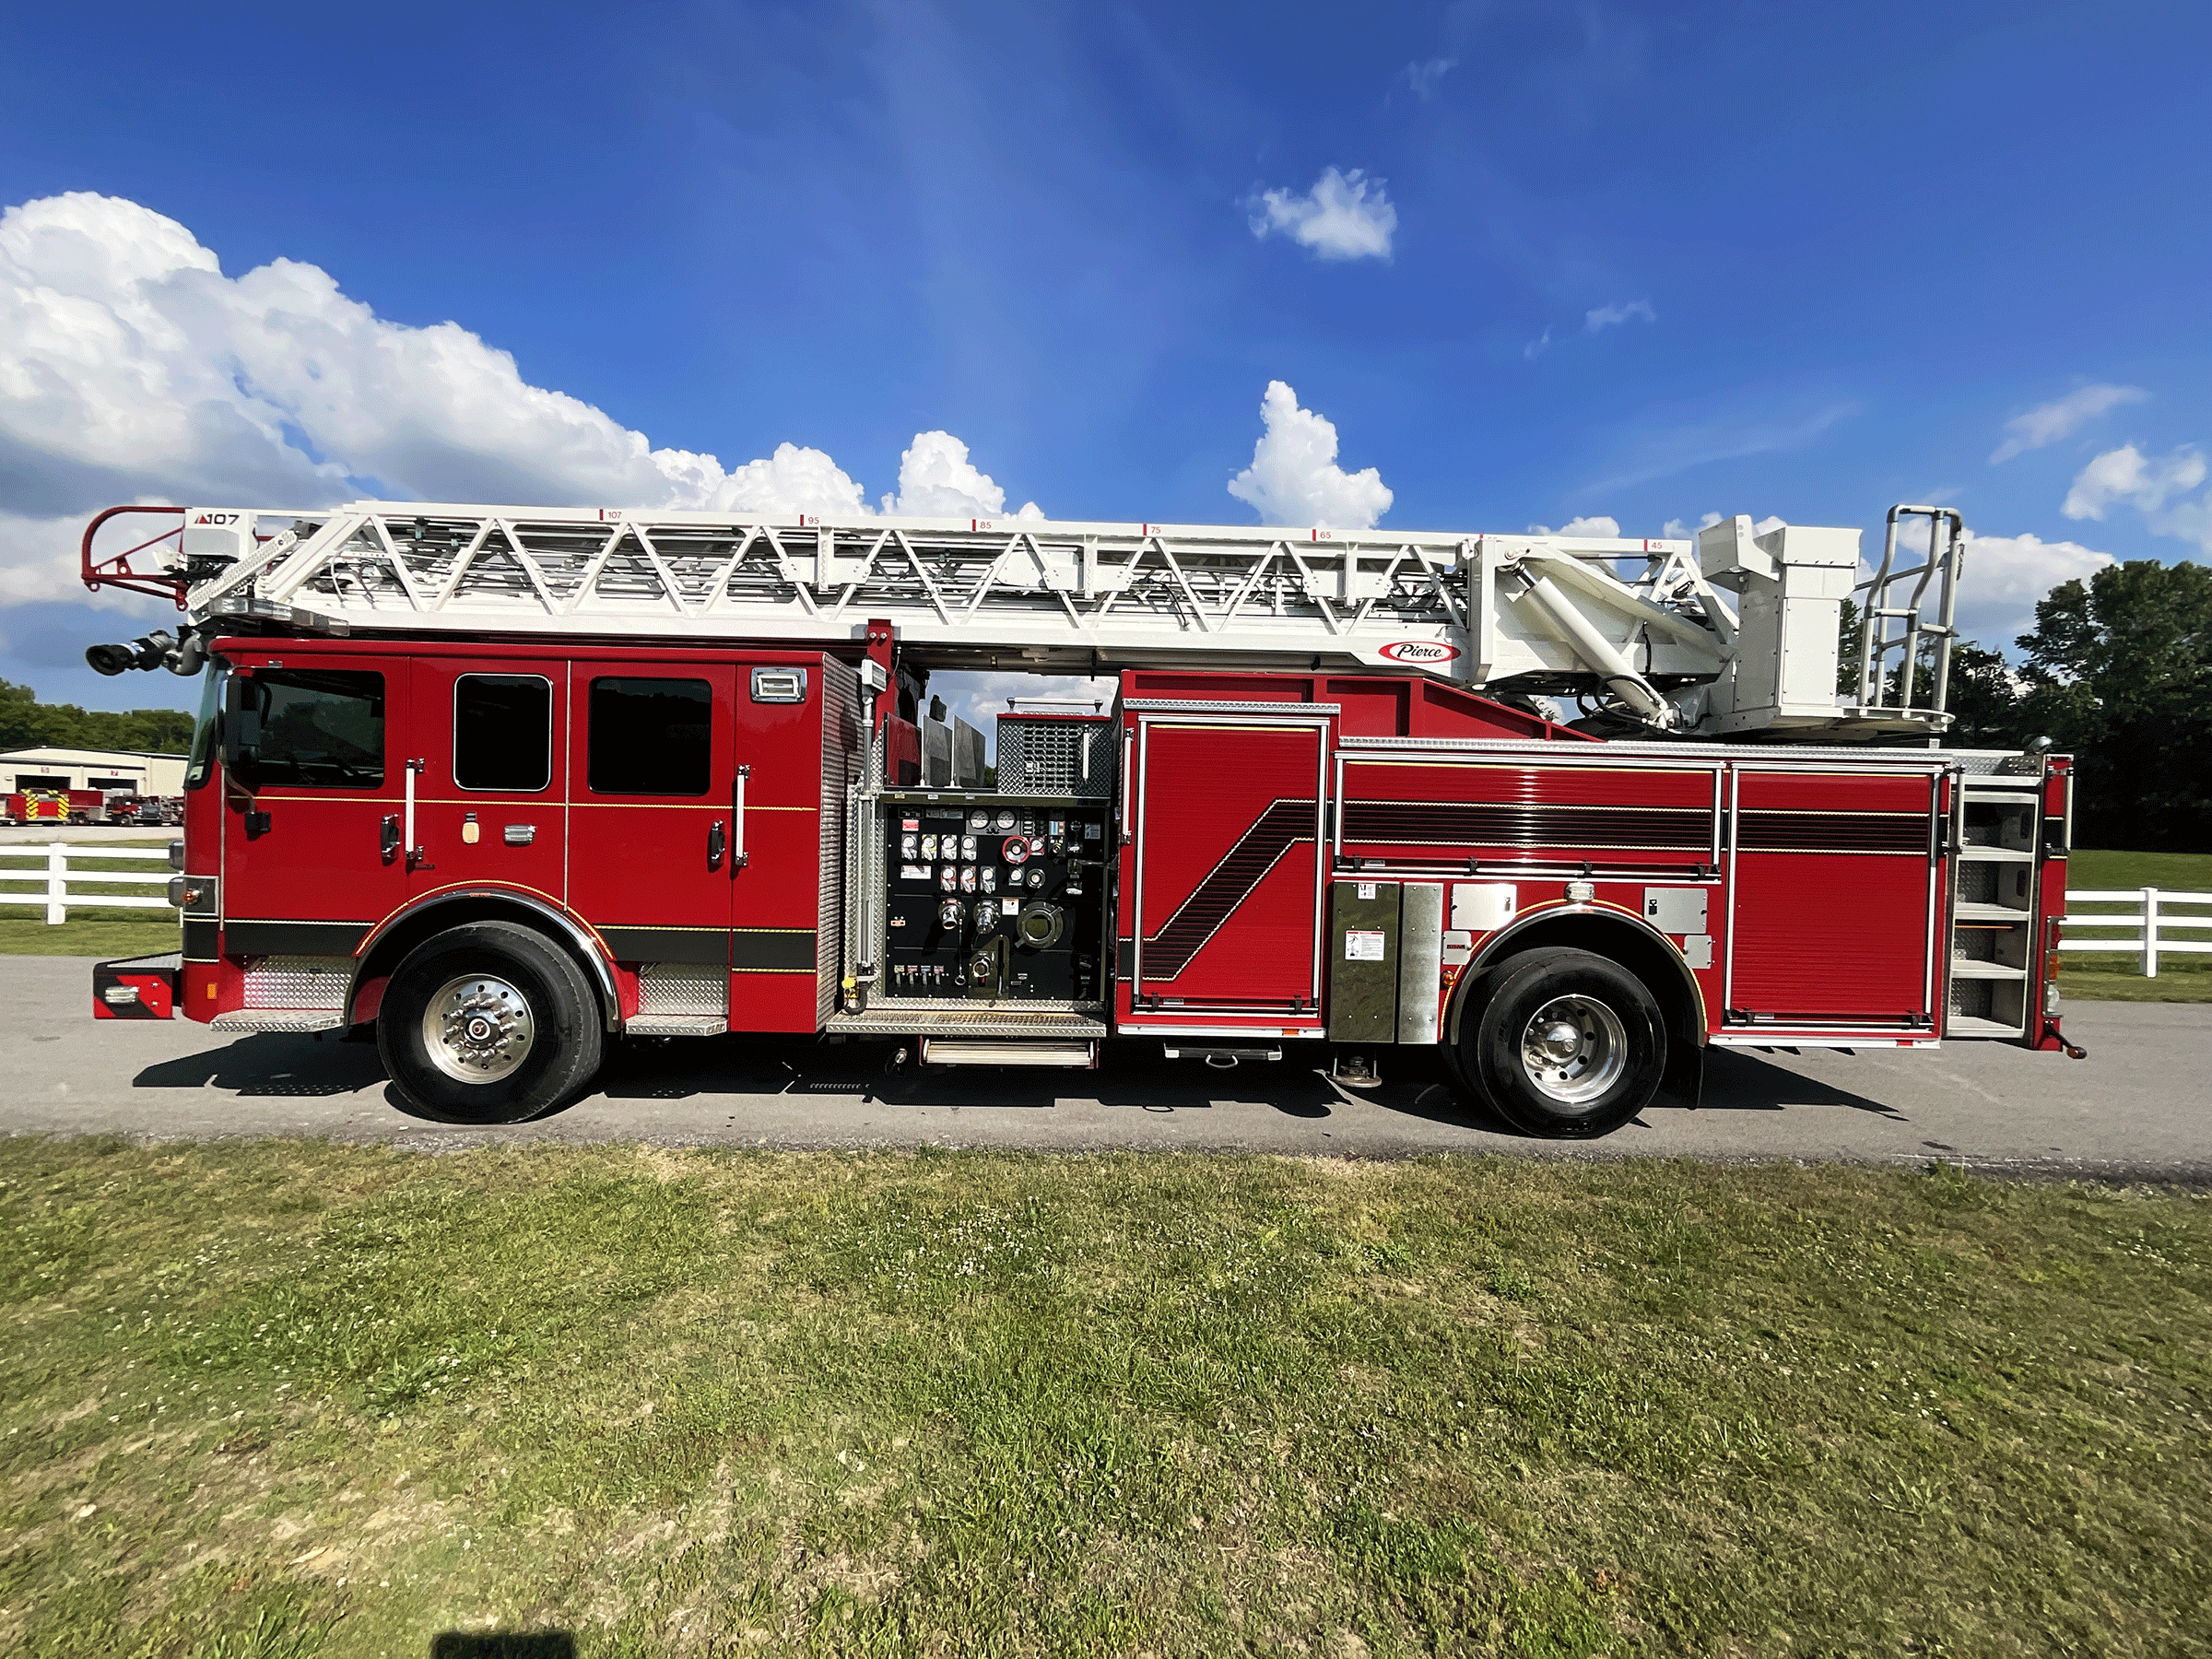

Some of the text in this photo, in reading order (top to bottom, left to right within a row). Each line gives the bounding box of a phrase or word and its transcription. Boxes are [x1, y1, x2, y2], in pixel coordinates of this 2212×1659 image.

[206, 513, 240, 525] 107
[608, 511, 622, 519] 107
[808, 516, 819, 524] 95
[980, 521, 992, 529] 85
[1150, 526, 1161, 535] 75
[1320, 531, 1332, 539] 65
[1397, 643, 1442, 658] Pierce
